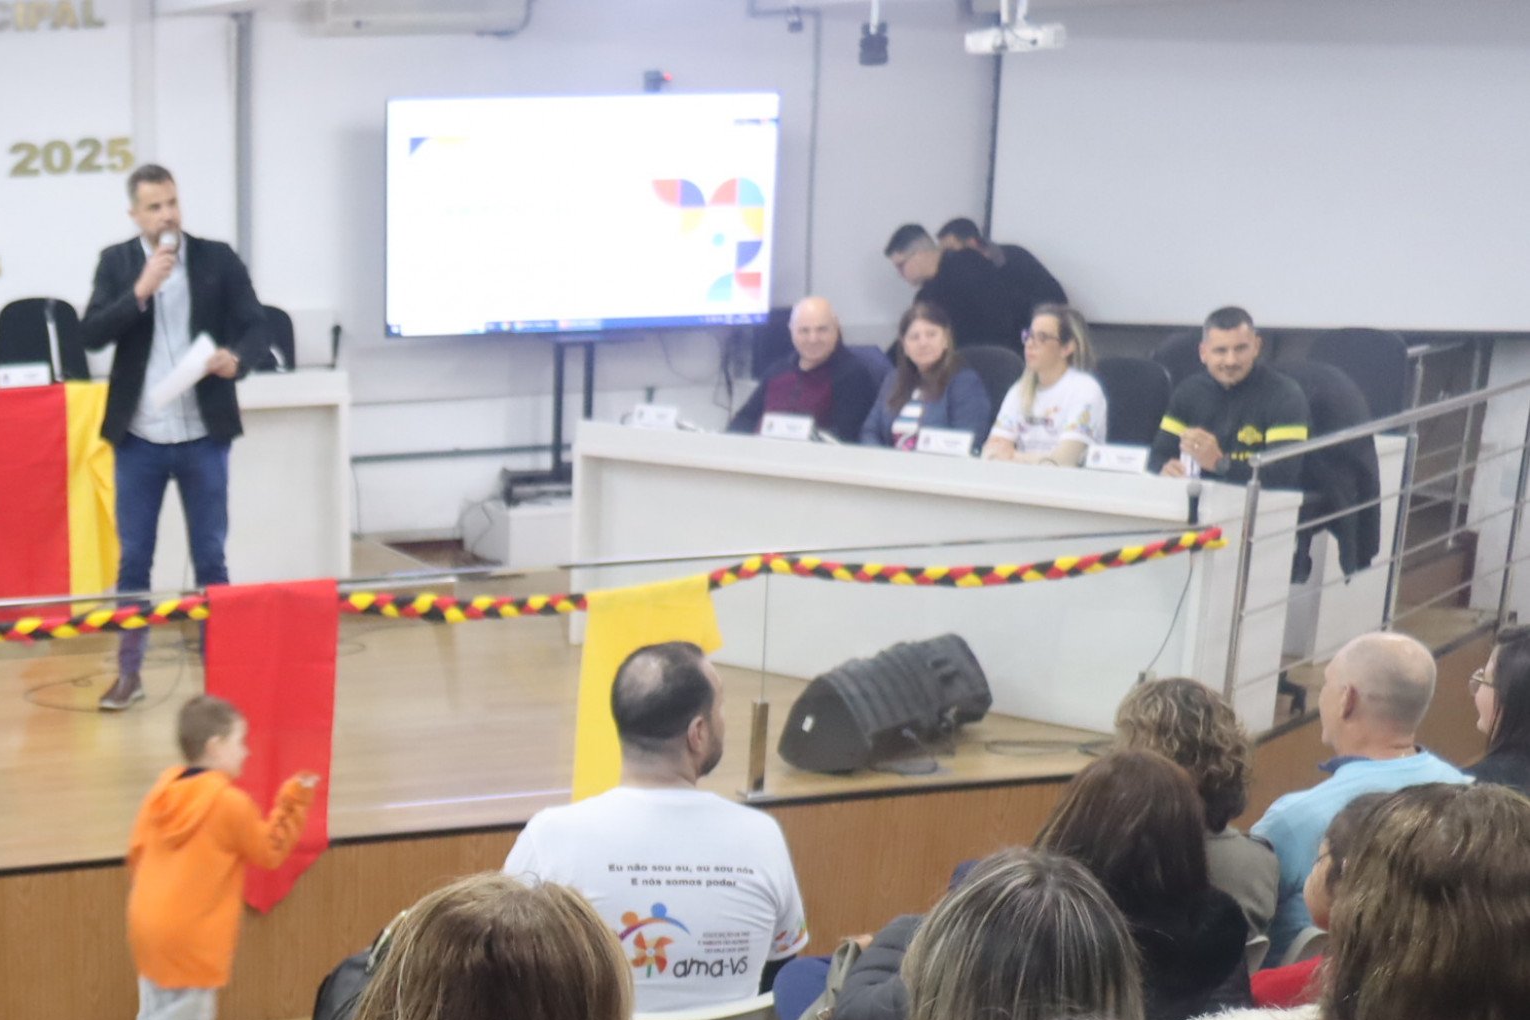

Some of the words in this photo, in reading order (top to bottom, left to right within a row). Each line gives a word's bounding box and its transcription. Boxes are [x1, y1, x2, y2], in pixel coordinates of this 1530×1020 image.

[8, 137, 134, 177] 2025
[608, 864, 623, 872] Eu
[627, 863, 648, 872] não
[713, 865, 733, 873] sou
[642, 877, 662, 886] nós
